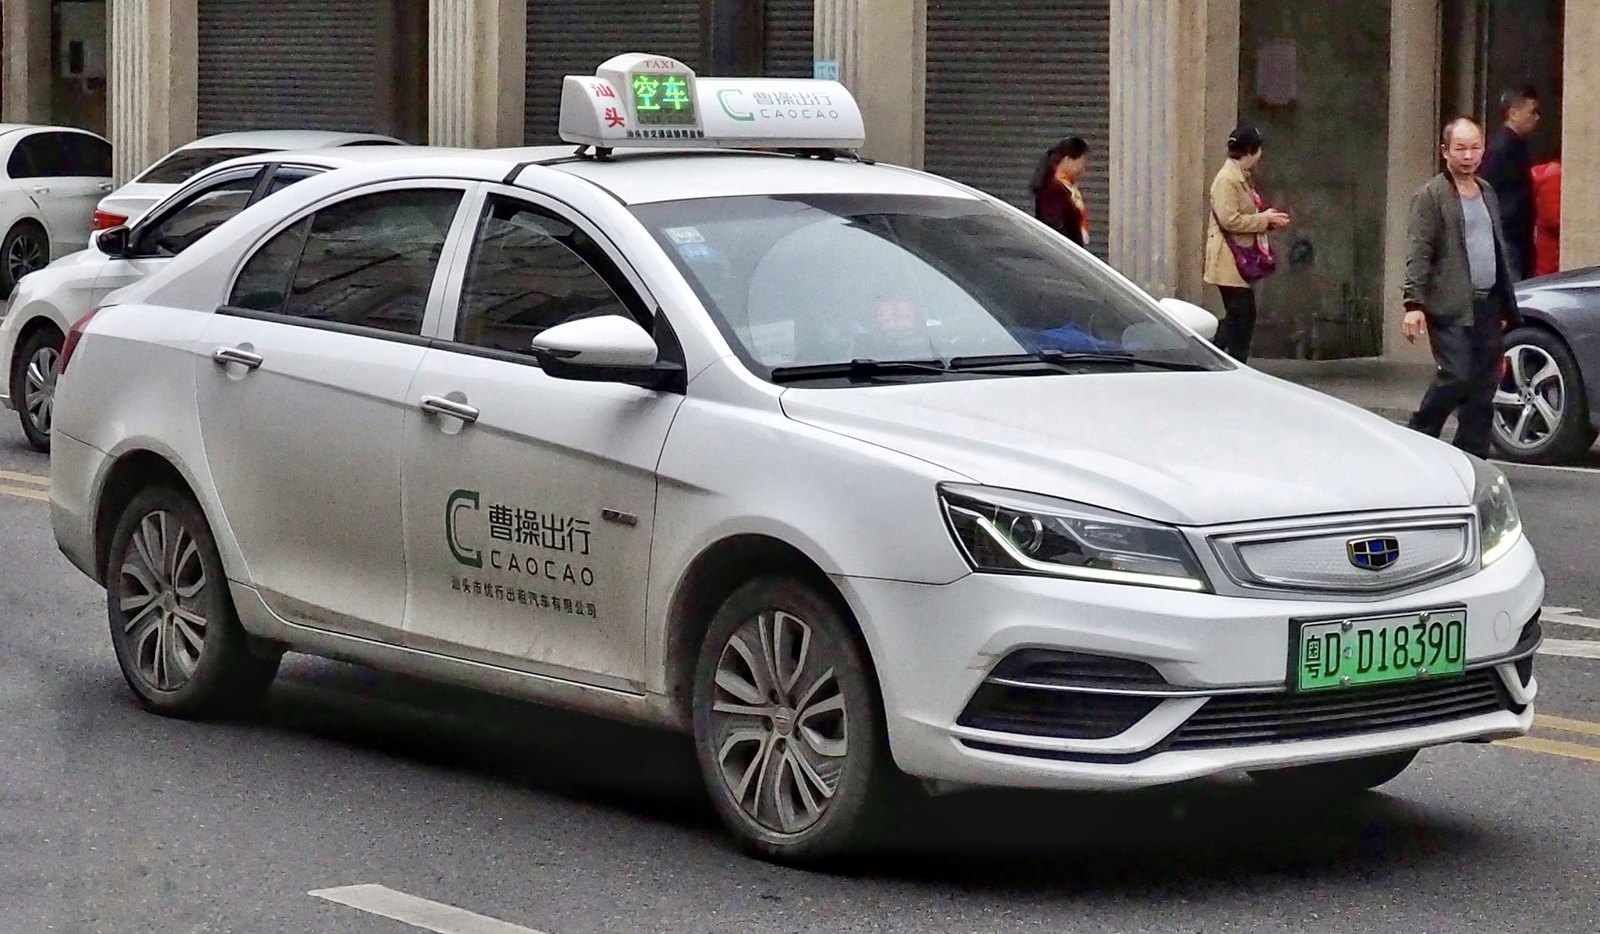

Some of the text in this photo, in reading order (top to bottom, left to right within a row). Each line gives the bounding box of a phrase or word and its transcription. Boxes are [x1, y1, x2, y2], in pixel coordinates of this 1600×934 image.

[644, 60, 675, 69] TAXI
[591, 83, 625, 128] 汕头
[633, 76, 690, 110] 空车
[753, 92, 833, 106] 曹操出行
[760, 109, 839, 120] CAOCAO
[489, 504, 591, 555] 曹操出行
[491, 550, 594, 587] CAOCAO
